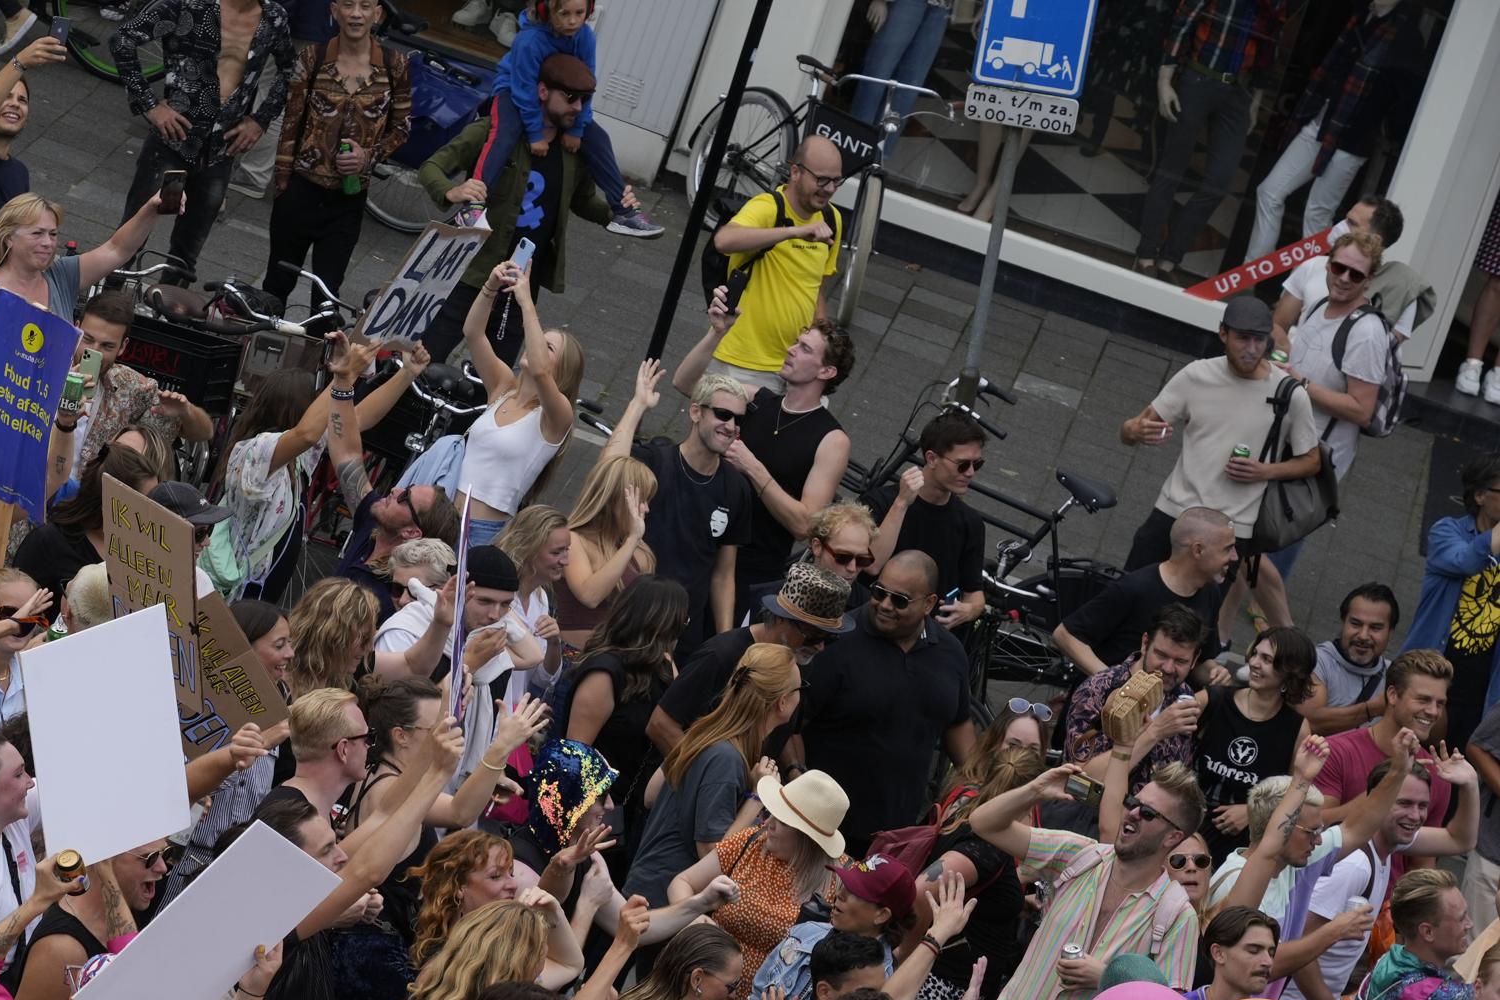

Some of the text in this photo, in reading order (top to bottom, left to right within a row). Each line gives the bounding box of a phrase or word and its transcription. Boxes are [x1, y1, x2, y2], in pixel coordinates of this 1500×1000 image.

[967, 105, 1071, 133] 9.00-12.00h
[973, 91, 1073, 117] ma. t/m za.
[815, 123, 873, 157] GANT
[403, 231, 479, 283] LAAT
[1214, 239, 1321, 294] UP TO 50%
[364, 287, 446, 342] DANS
[4, 362, 49, 399] Houd 1.5
[11, 418, 43, 442] elkaar
[111, 496, 171, 552] IK WIL
[108, 533, 173, 589] ALLEEN
[220, 665, 266, 716] ALLEEN
